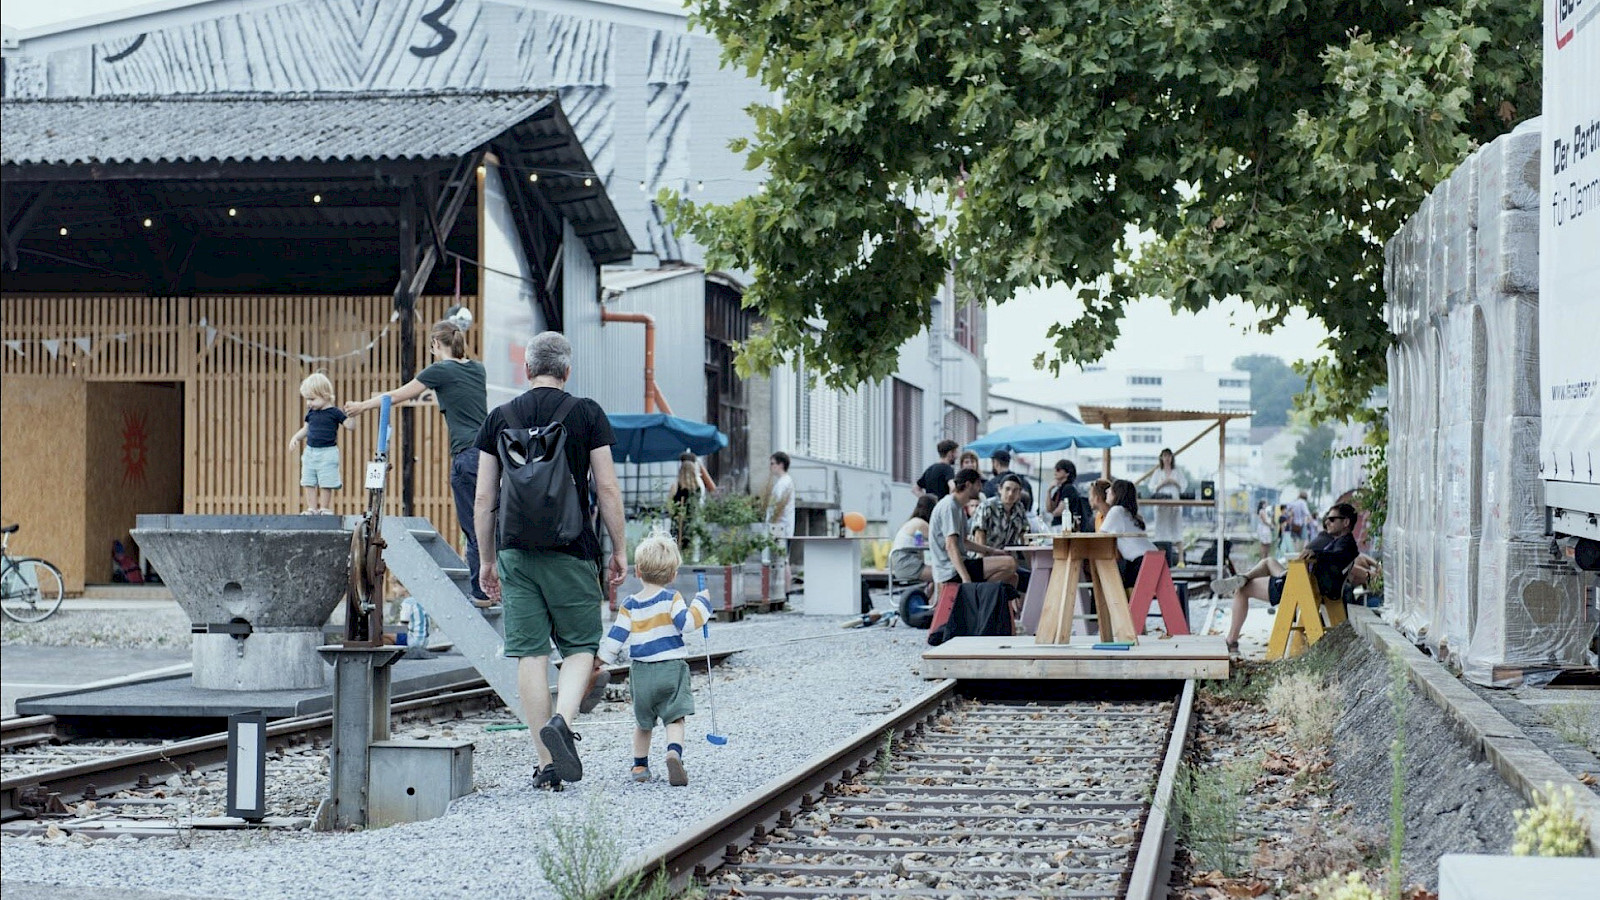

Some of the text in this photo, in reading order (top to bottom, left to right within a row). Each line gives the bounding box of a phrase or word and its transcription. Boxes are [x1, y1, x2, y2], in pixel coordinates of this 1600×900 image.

[409, 0, 457, 58] 3
[1554, 138, 1570, 175] Der
[1552, 190, 1568, 227] für
